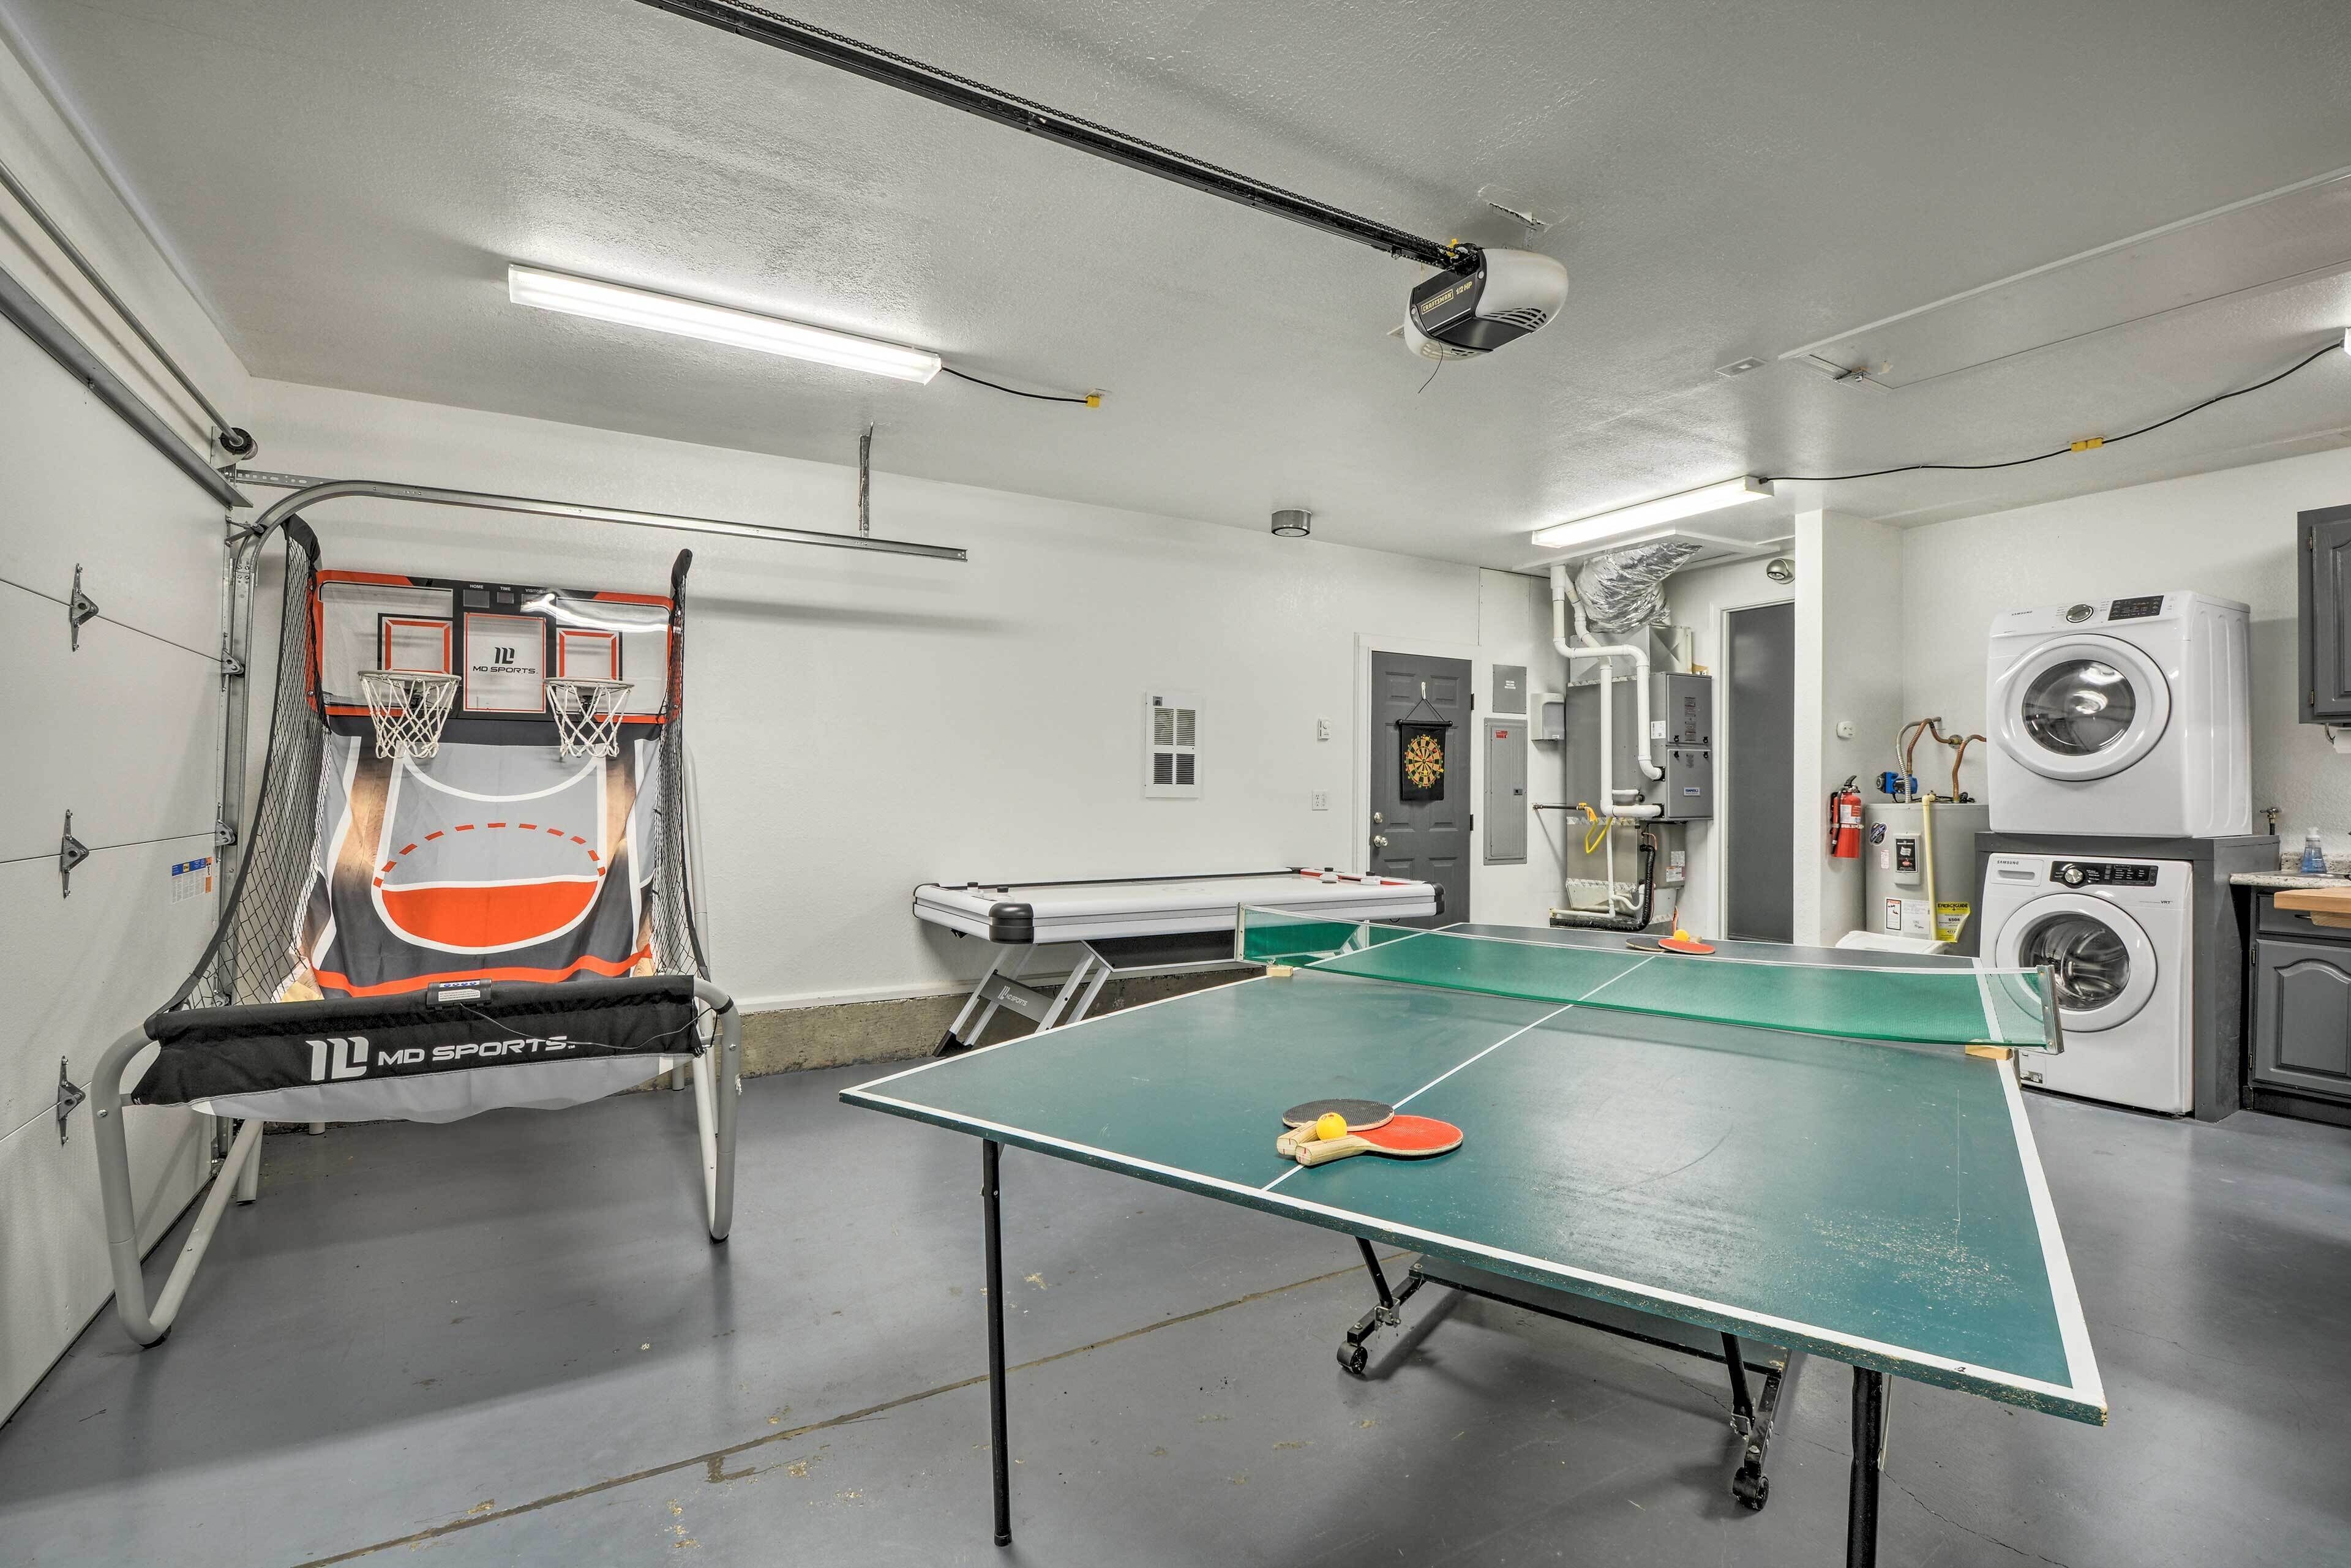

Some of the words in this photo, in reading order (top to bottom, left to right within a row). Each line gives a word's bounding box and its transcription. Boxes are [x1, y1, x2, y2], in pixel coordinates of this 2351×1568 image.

[1423, 293, 1452, 312] CRAFTSMAN
[378, 1049, 425, 1066] MD
[432, 1036, 567, 1062] SPORTS
